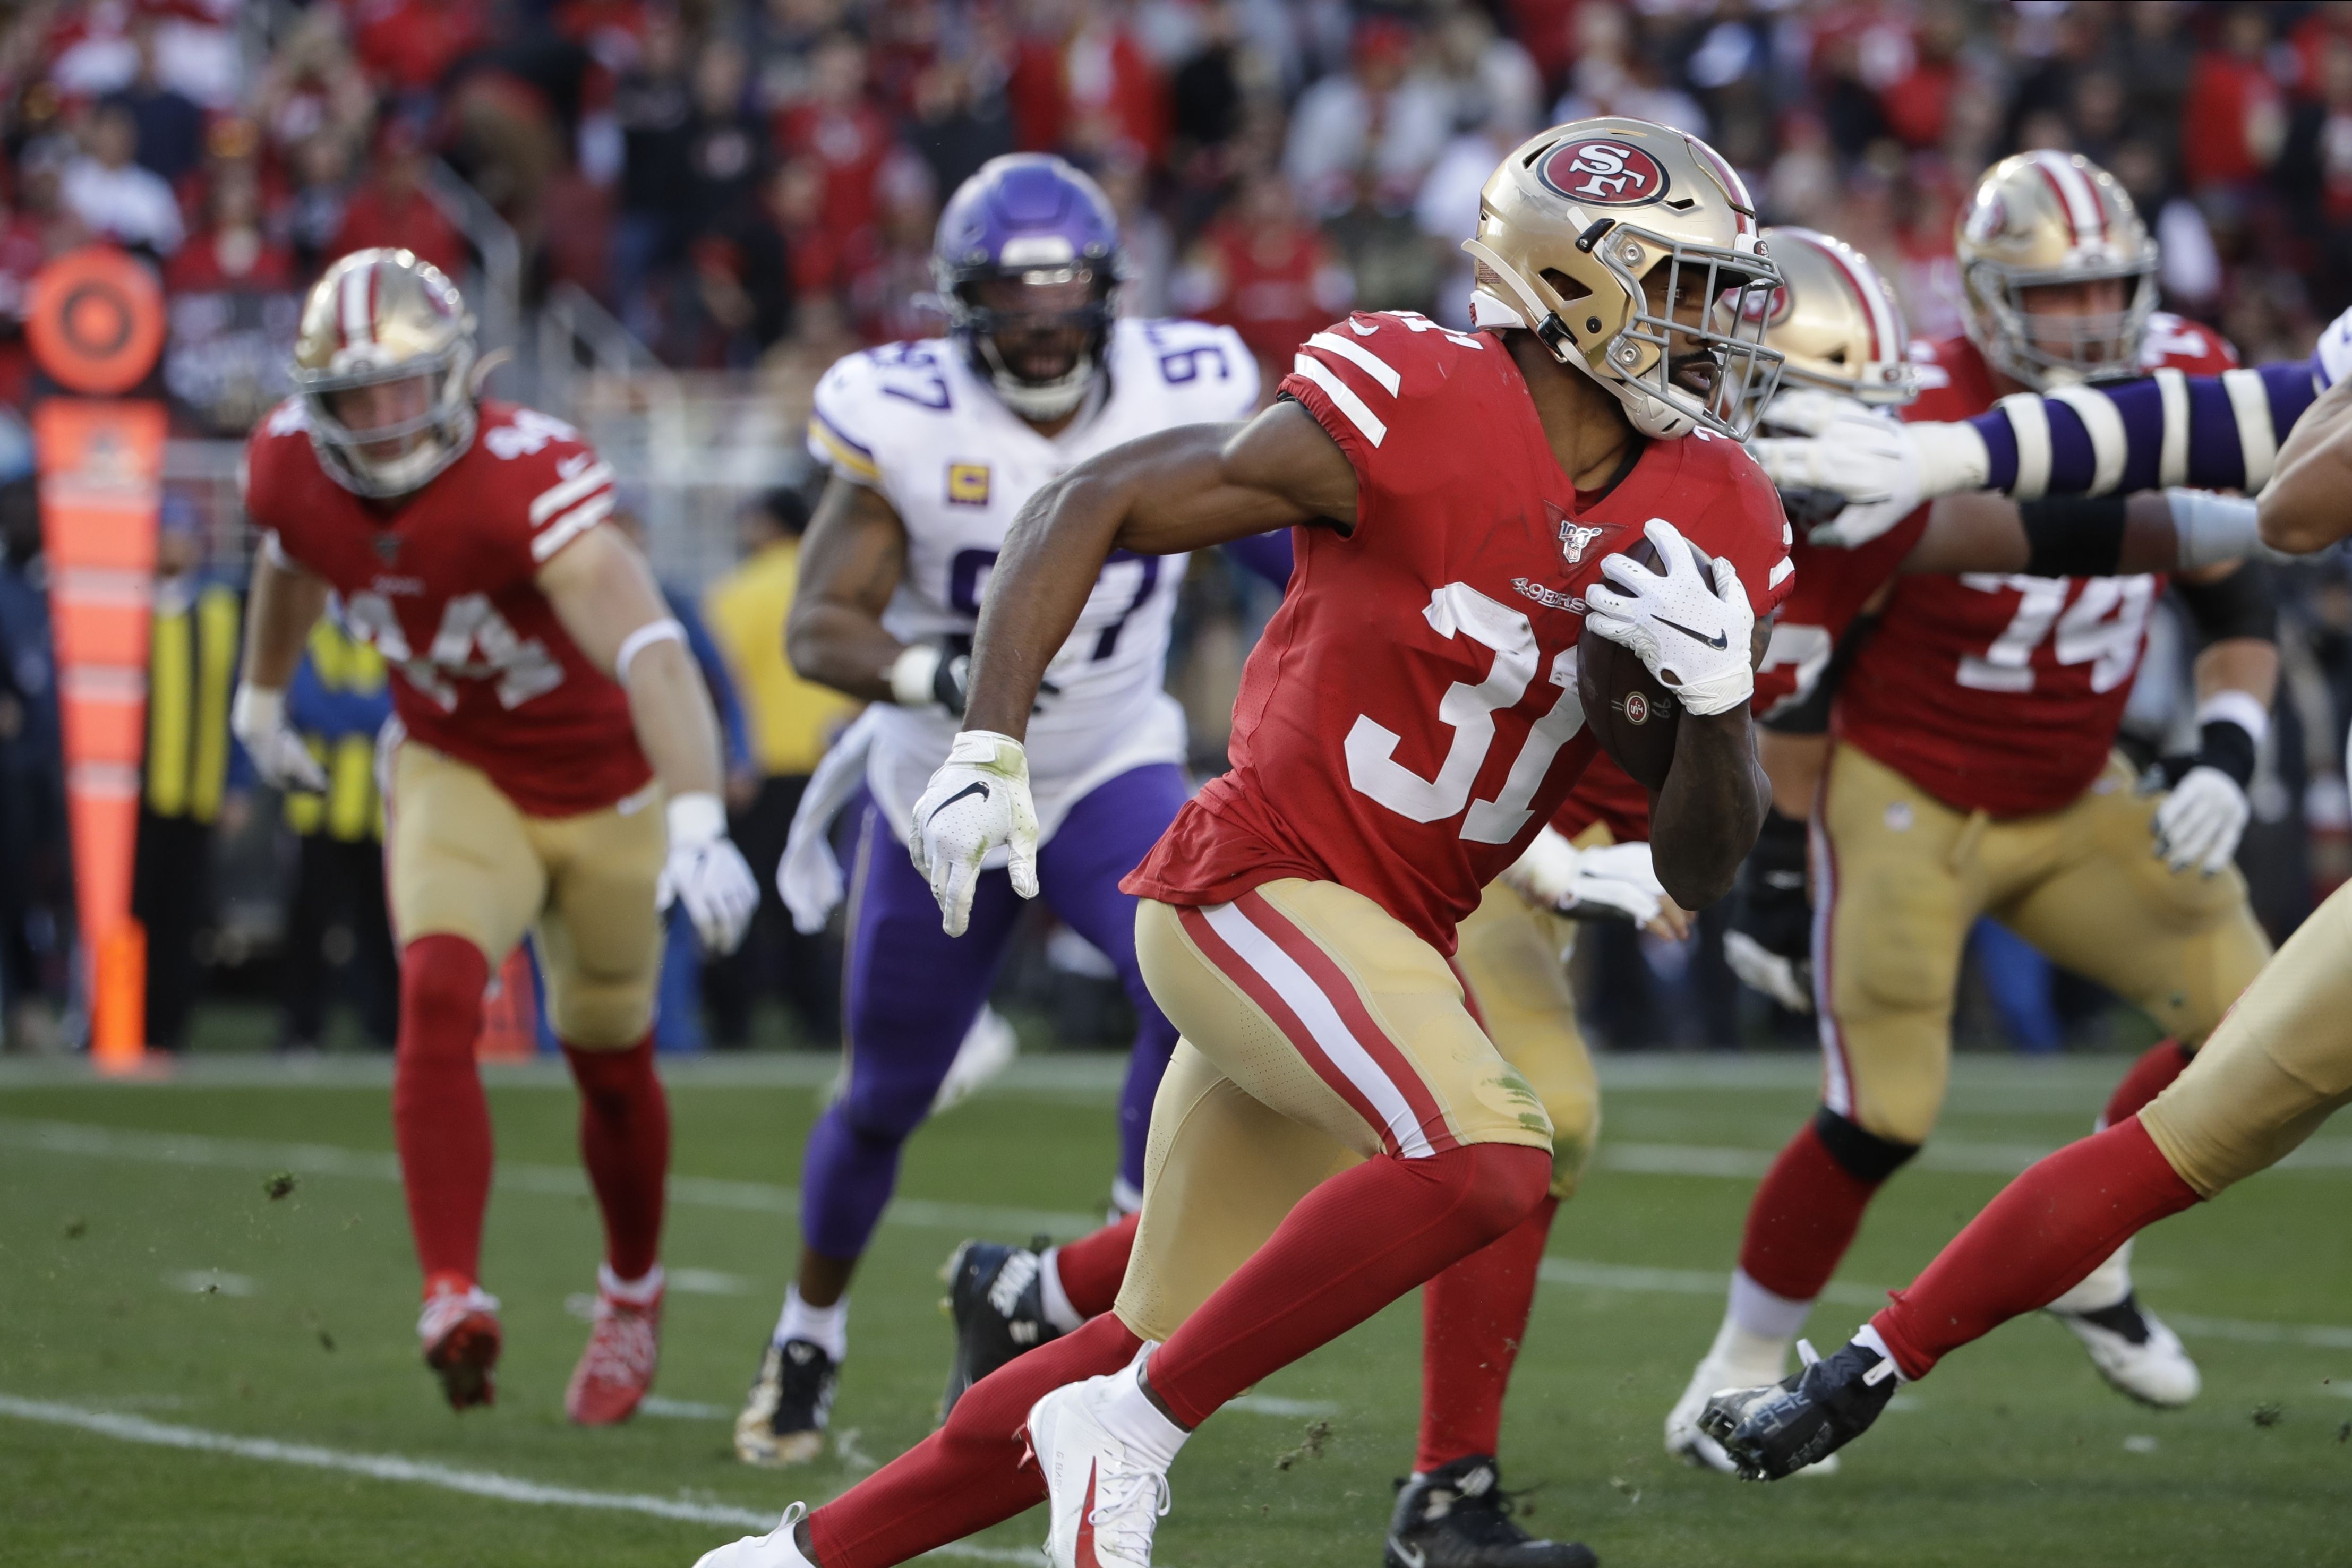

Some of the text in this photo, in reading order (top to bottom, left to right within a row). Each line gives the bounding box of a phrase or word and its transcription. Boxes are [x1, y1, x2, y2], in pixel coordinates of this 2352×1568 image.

[1569, 144, 1646, 197] SF
[1510, 578, 1586, 611] 49ERS
[1344, 581, 1586, 844] 31
